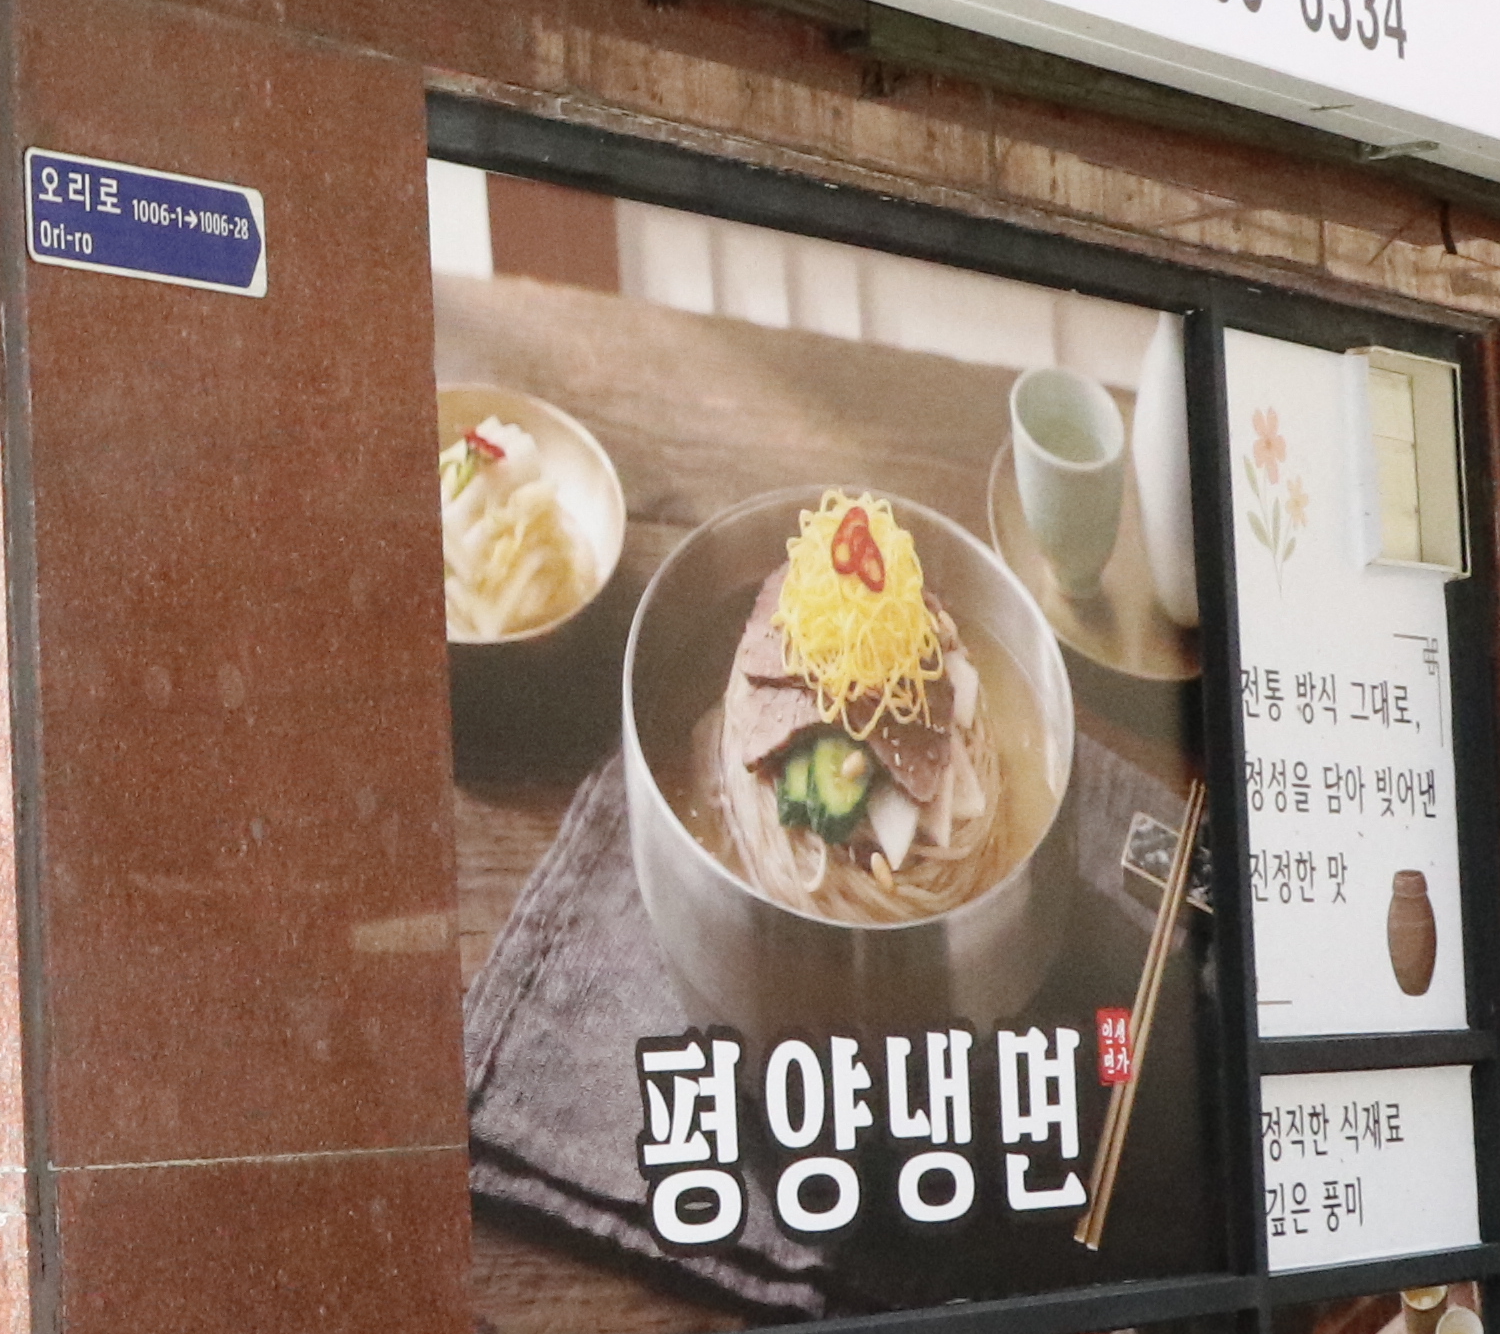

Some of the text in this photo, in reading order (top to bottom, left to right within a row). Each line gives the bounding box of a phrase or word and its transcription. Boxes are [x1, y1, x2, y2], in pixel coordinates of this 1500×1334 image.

[38, 166, 250, 240] 오리로 1006-1 1006-28
[39, 219, 94, 255] Ori-ro
[1240, 665, 1421, 734] 전통 방식 그대로,
[1245, 757, 1437, 819] 정성을 담아 빚어낸
[1249, 849, 1348, 905] 진정한 맛
[642, 1026, 1088, 1244] 평양냉면
[1260, 1100, 1405, 1162] 정직한 식재료
[1266, 1176, 1364, 1237] 깊은 풍미
